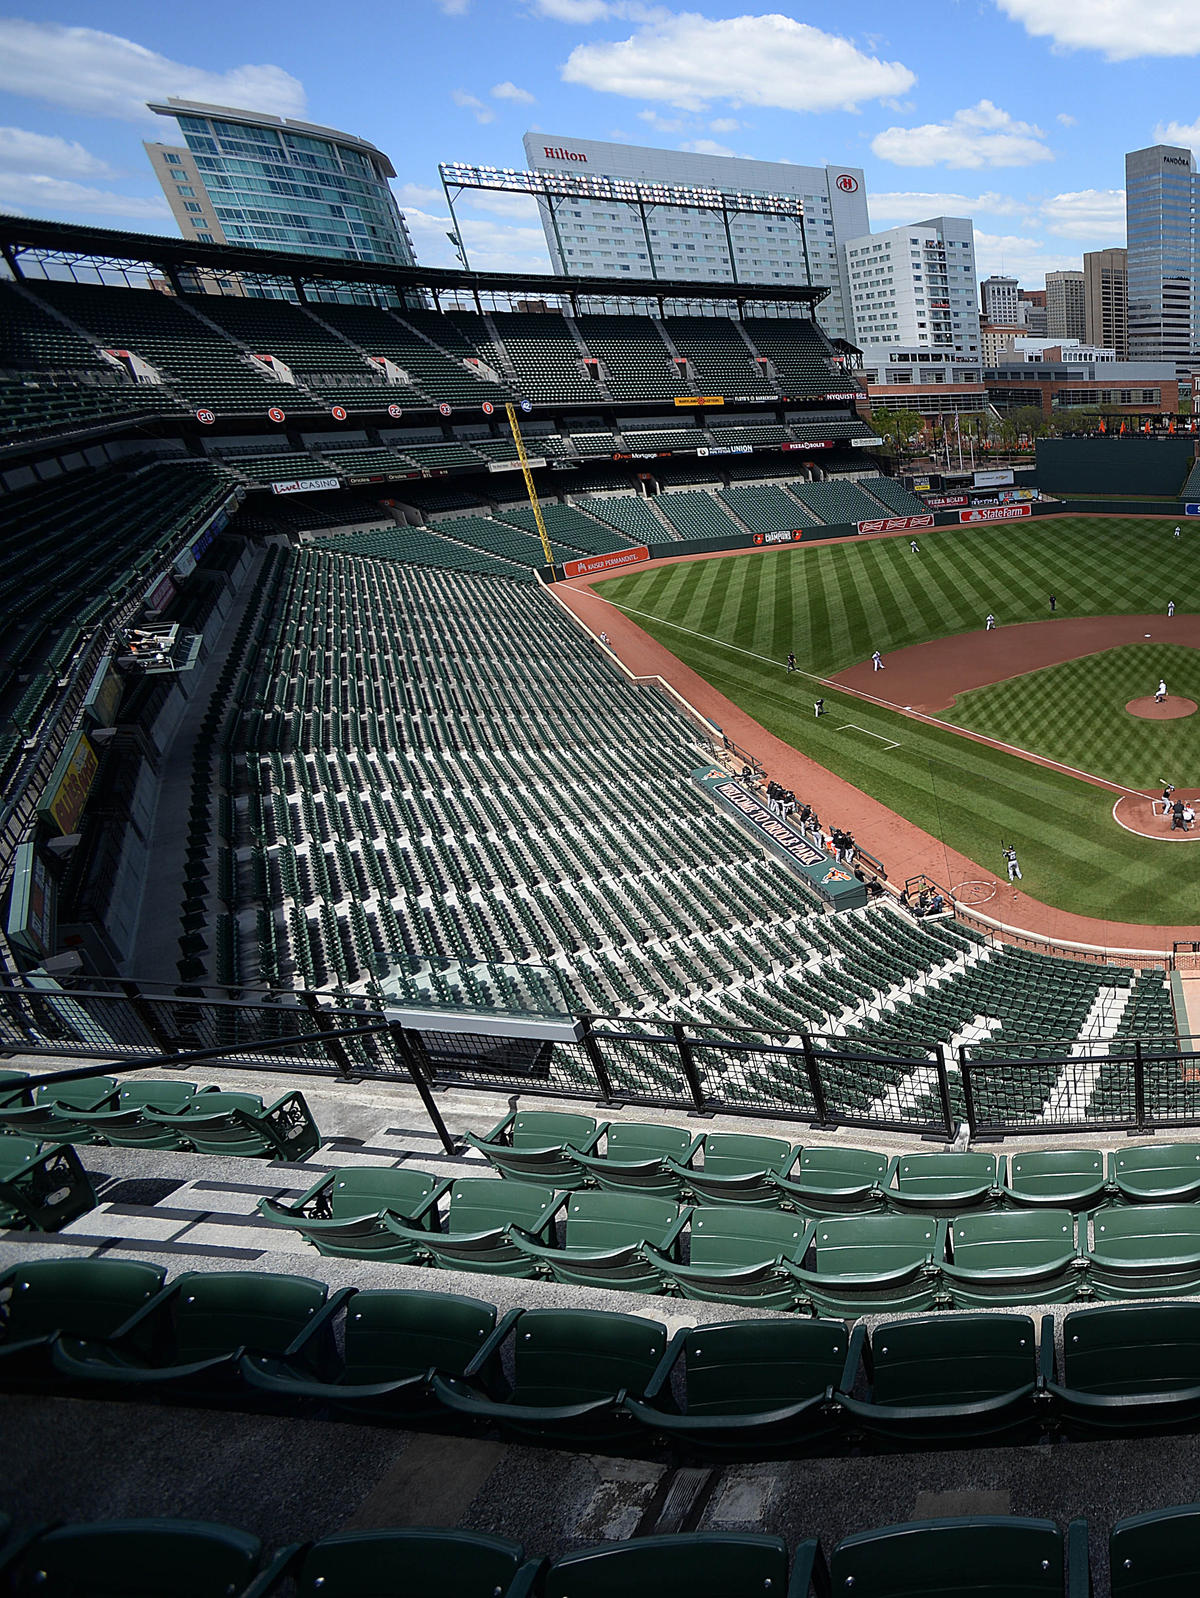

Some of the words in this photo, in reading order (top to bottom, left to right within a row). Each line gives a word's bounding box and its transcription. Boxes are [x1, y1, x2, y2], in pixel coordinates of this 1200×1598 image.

[544, 146, 588, 162] Hilton
[1163, 156, 1189, 166] PANDORA
[274, 411, 281, 420] 5
[336, 409, 343, 418] 4
[390, 407, 400, 415] 22
[200, 412, 214, 422] 20
[730, 444, 753, 454] UNION
[300, 479, 338, 490] CASINO
[587, 560, 605, 570] KAISER
[719, 783, 759, 814] WELCOME
[750, 807, 769, 823] TO
[761, 820, 797, 847] ORIOLE
[788, 839, 823, 865] PARK
